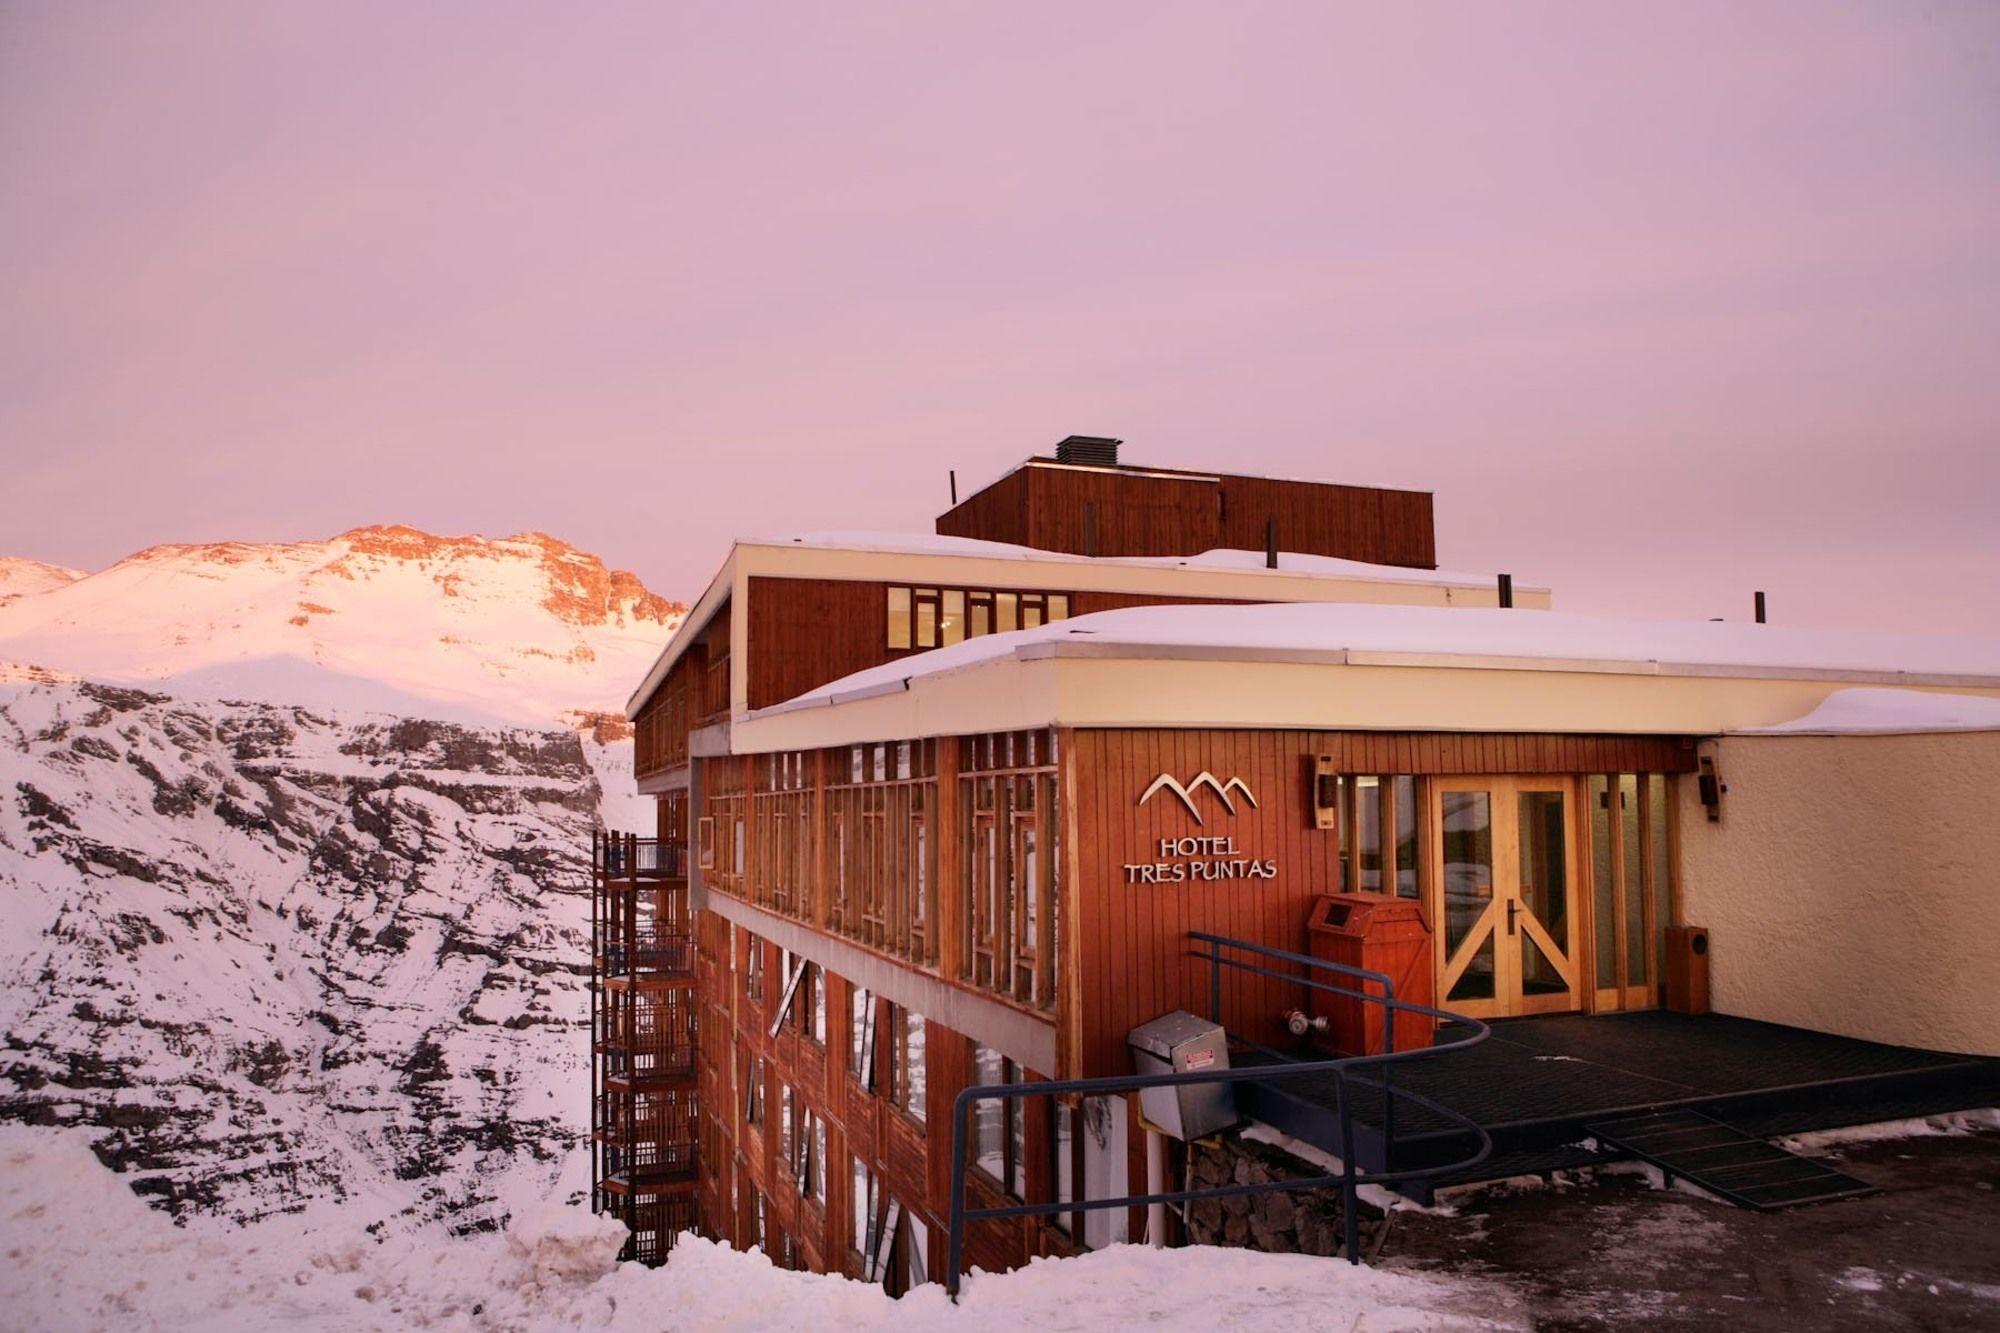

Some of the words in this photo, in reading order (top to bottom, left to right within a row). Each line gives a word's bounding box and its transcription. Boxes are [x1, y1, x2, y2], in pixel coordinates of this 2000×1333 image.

[1161, 837, 1240, 857] HOTEL
[1124, 863, 1185, 883] TRES
[1190, 859, 1277, 881] PUNTAS
